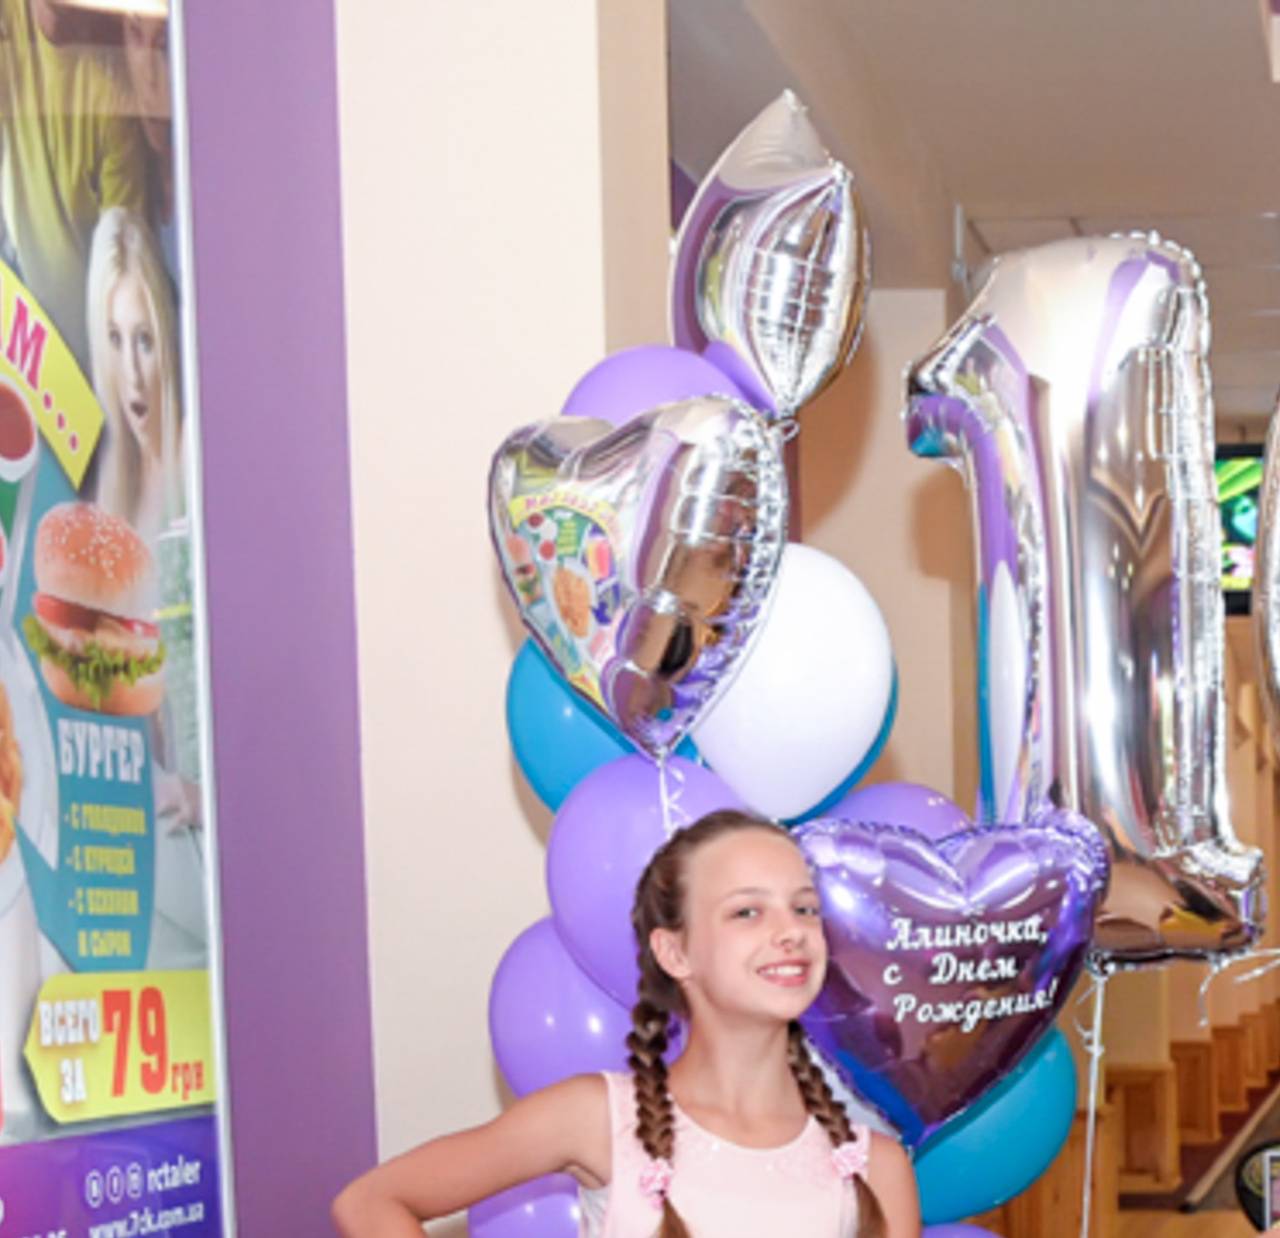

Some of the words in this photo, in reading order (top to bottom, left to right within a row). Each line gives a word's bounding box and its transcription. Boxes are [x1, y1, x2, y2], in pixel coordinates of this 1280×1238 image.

[57, 718, 145, 784] БУРГЕР
[886, 914, 1048, 950] Алиночка,
[882, 963, 902, 985] с
[893, 977, 1059, 1033] Рождения!
[102, 986, 169, 1098] 79
[171, 1059, 204, 1101] грн
[60, 1057, 87, 1105] ЗА
